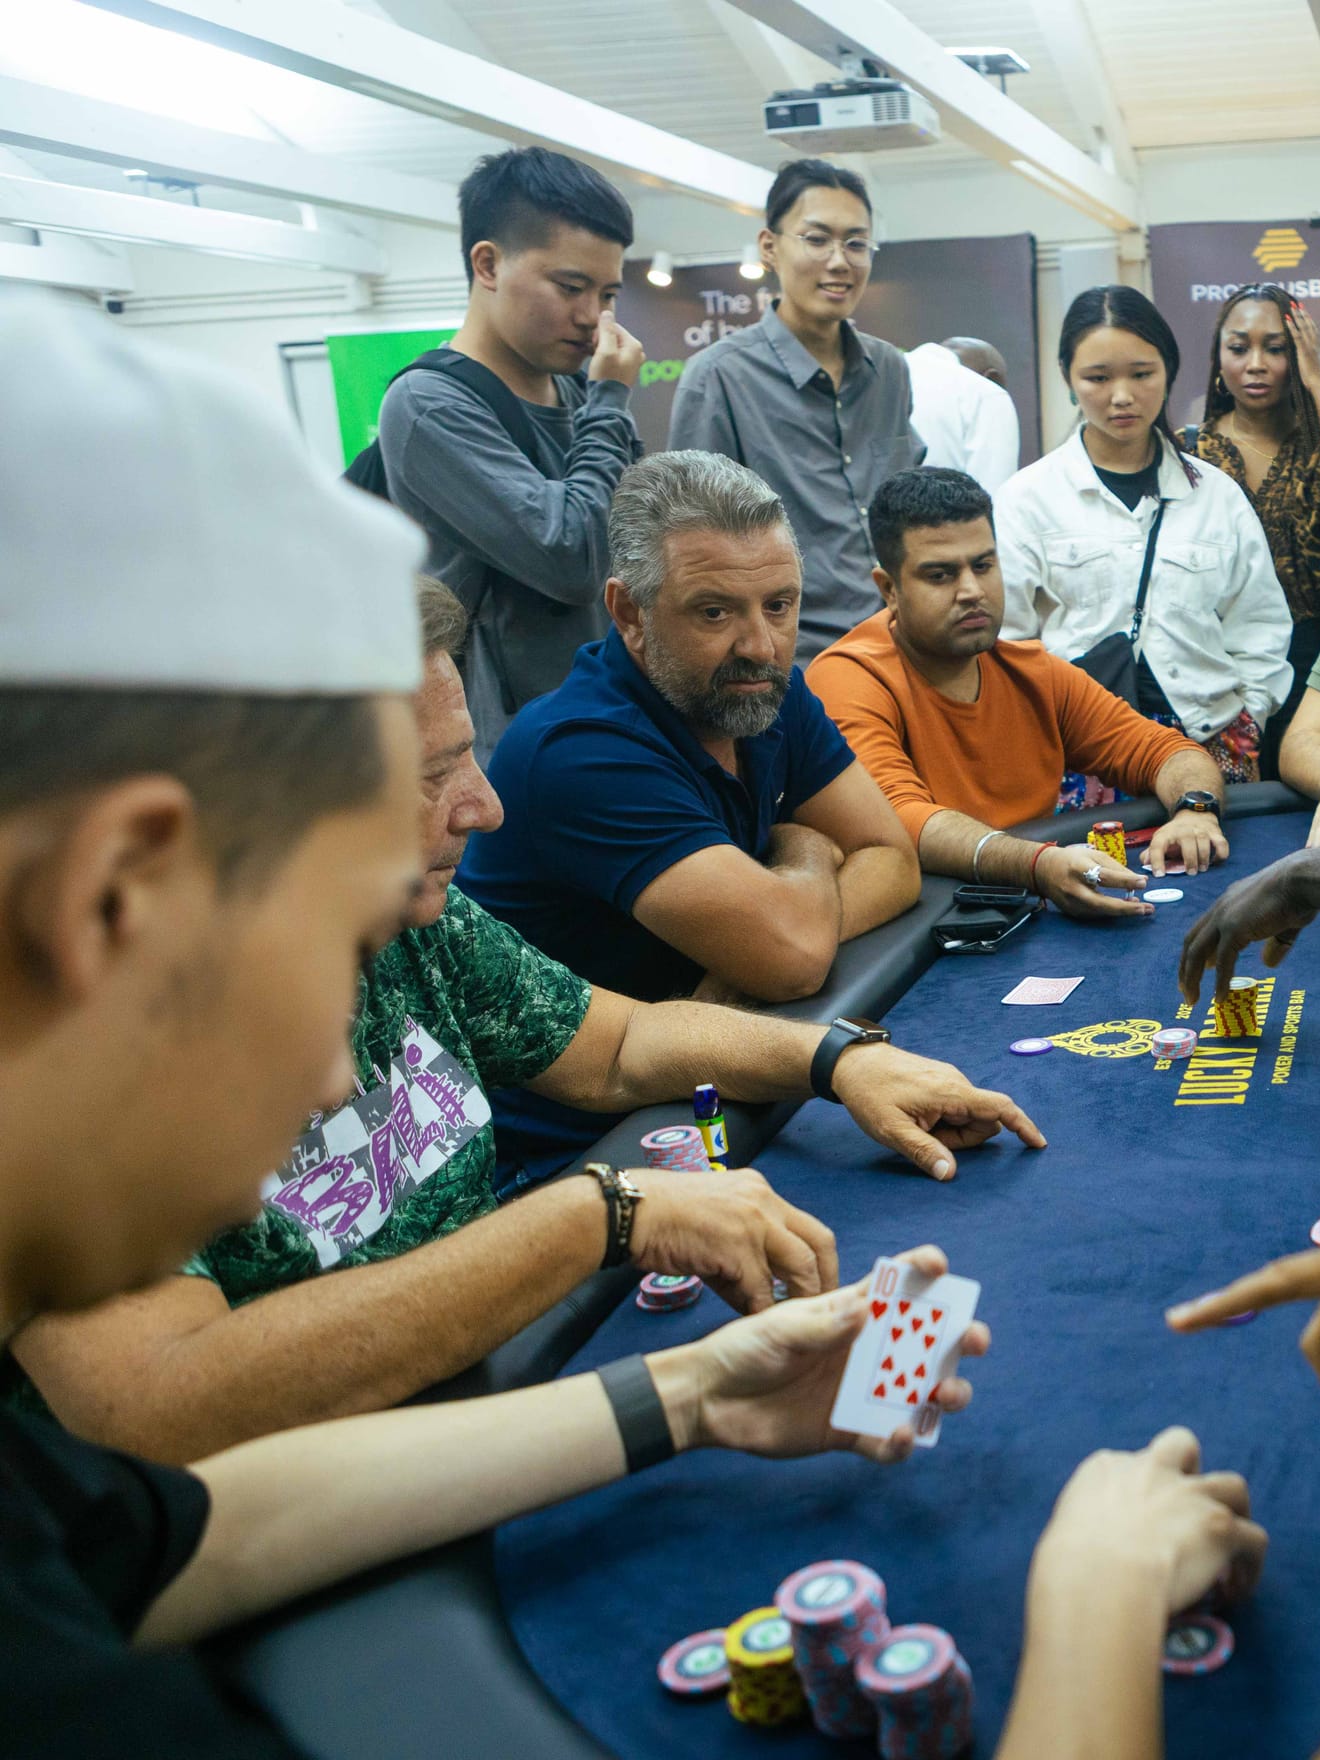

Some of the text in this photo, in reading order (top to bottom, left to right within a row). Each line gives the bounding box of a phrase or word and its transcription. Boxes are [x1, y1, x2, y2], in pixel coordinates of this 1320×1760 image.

[702, 289, 752, 315] The
[684, 320, 713, 348] of
[1271, 989, 1306, 1084] POKER AND SPORTS BAR
[1174, 1046, 1258, 1106] LUCKY
[874, 1265, 899, 1297] 10
